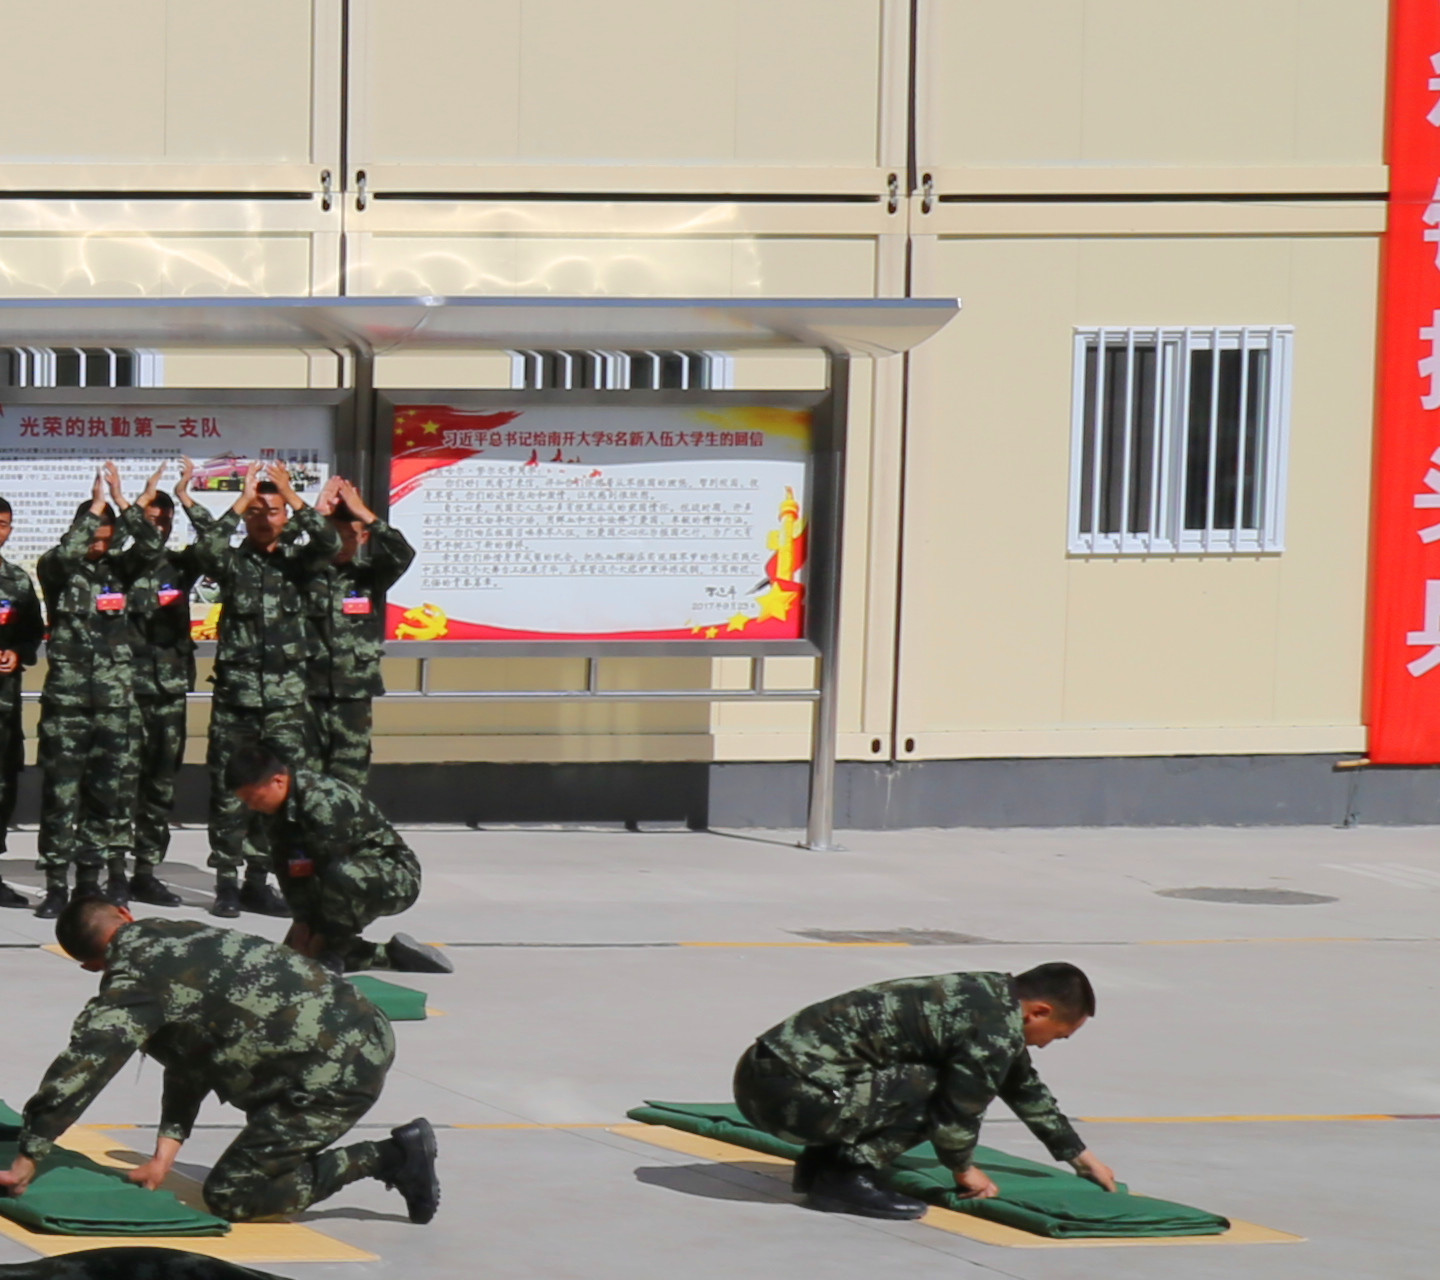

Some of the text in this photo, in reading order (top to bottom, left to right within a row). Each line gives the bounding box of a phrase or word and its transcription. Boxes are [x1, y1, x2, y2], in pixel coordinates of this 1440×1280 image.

[20, 416, 221, 438] 光荣的执勤第一支队
[442, 431, 763, 447] 习近平总书记给南开大学8名新入伍大学生的回信
